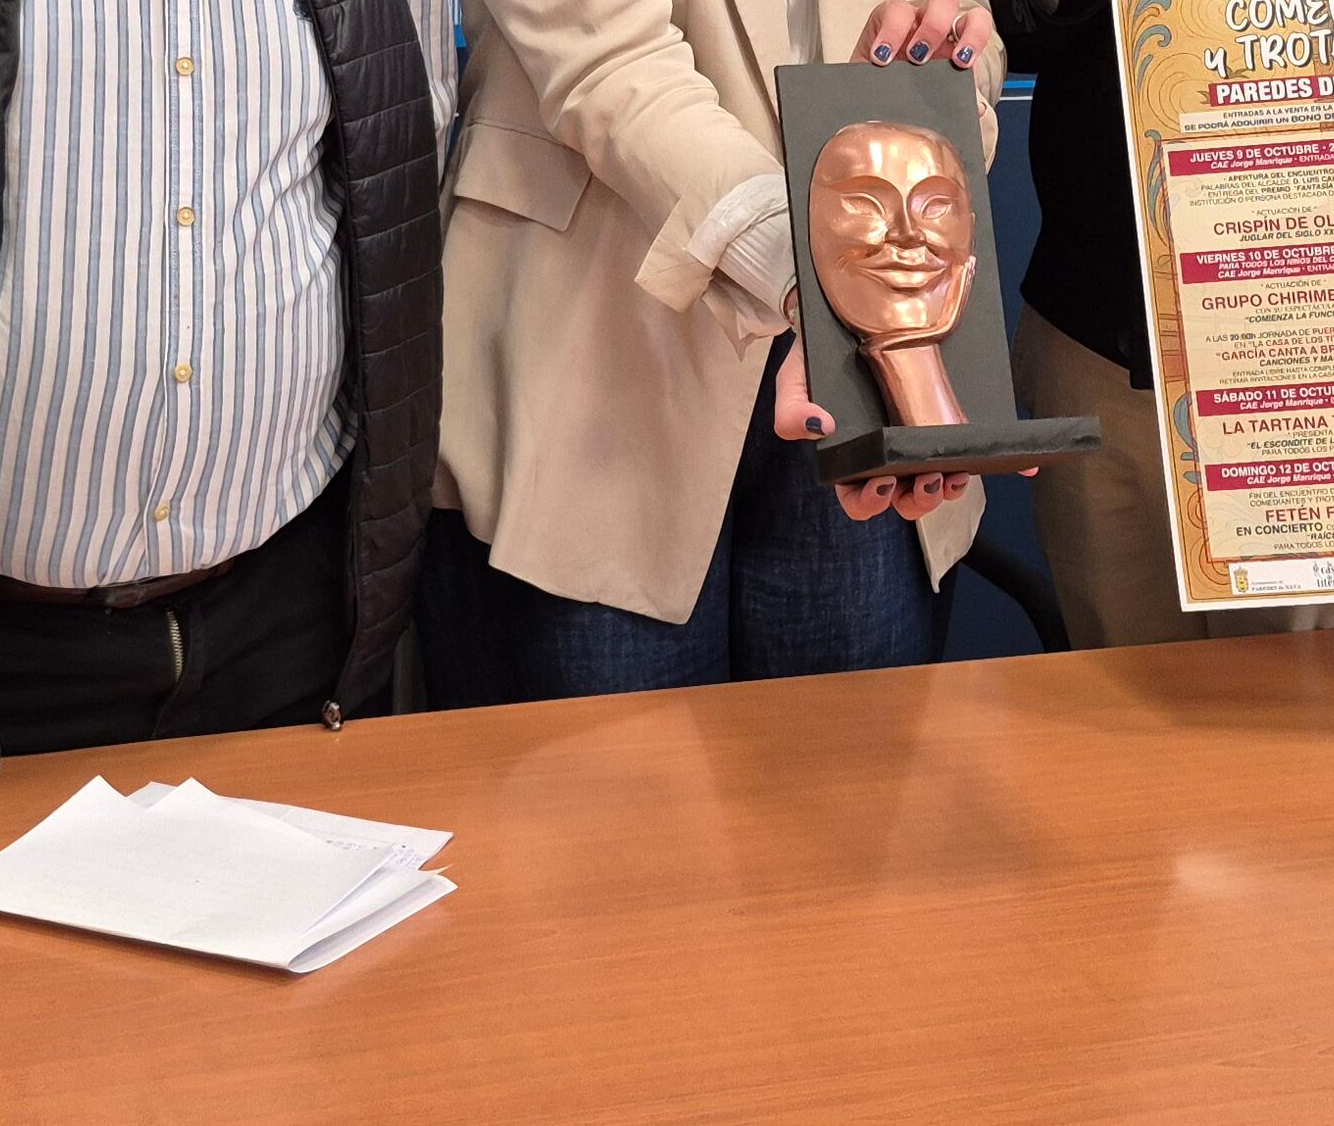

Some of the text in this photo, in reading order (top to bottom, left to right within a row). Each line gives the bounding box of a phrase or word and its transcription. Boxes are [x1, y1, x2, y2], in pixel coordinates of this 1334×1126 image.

[1215, 77, 1312, 105] PAREDES
[1223, 109, 1263, 119] ENTRADAS
[1284, 106, 1308, 114] VENTA
[1184, 124, 1196, 132] SE
[1198, 120, 1229, 130] PODRÁ
[1230, 117, 1274, 128] ADQUIRIR
[1276, 116, 1289, 124] UN
[1291, 113, 1322, 122] BONO
[1190, 151, 1234, 163] JUEVES
[1236, 150, 1243, 159] 9
[1245, 148, 1261, 158] DE
[1264, 143, 1318, 157] OCTUBRE
[1210, 161, 1228, 169] CAE
[1230, 159, 1253, 169] Jorge
[1255, 156, 1293, 167] Manrique
[1299, 153, 1334, 162] ENTRADA
[1213, 215, 1282, 236] CRISPÍN
[1285, 216, 1308, 230] DE
[1239, 233, 1273, 242] JUGLAR
[1276, 231, 1292, 239] DEL
[1295, 229, 1321, 238] SIGLO
[1196, 252, 1245, 265] VIERNES
[1248, 251, 1261, 261] 10
[1264, 249, 1279, 260] DE
[1201, 293, 1262, 311] GRUPO
[1257, 329, 1297, 339] JORNADA
[1298, 328, 1309, 336] DE
[1268, 345, 1306, 358] CANTA
[1308, 344, 1317, 354] A
[1259, 356, 1310, 367] CANCIONES
[1213, 388, 1261, 403] SÁBADO
[1265, 390, 1277, 400] 11
[1280, 388, 1296, 399] DE
[1239, 402, 1258, 410] CAE
[1259, 400, 1283, 409] Jorge
[1285, 397, 1323, 408] Manrique
[1222, 421, 1244, 435] LA
[1248, 415, 1328, 433] TARTANA
[1263, 438, 1312, 449] ESCONDITE
[1315, 436, 1327, 445] DE
[1221, 464, 1276, 478] DOMINGO
[1279, 464, 1291, 474] 12
[1294, 462, 1310, 473] DE
[1246, 476, 1265, 485] CAE
[1266, 474, 1291, 484] Jorge
[1292, 472, 1331, 482] Manrique
[1264, 503, 1321, 523] FETÉN
[1236, 526, 1252, 536] EN
[1255, 521, 1323, 535] CONCIERTO
